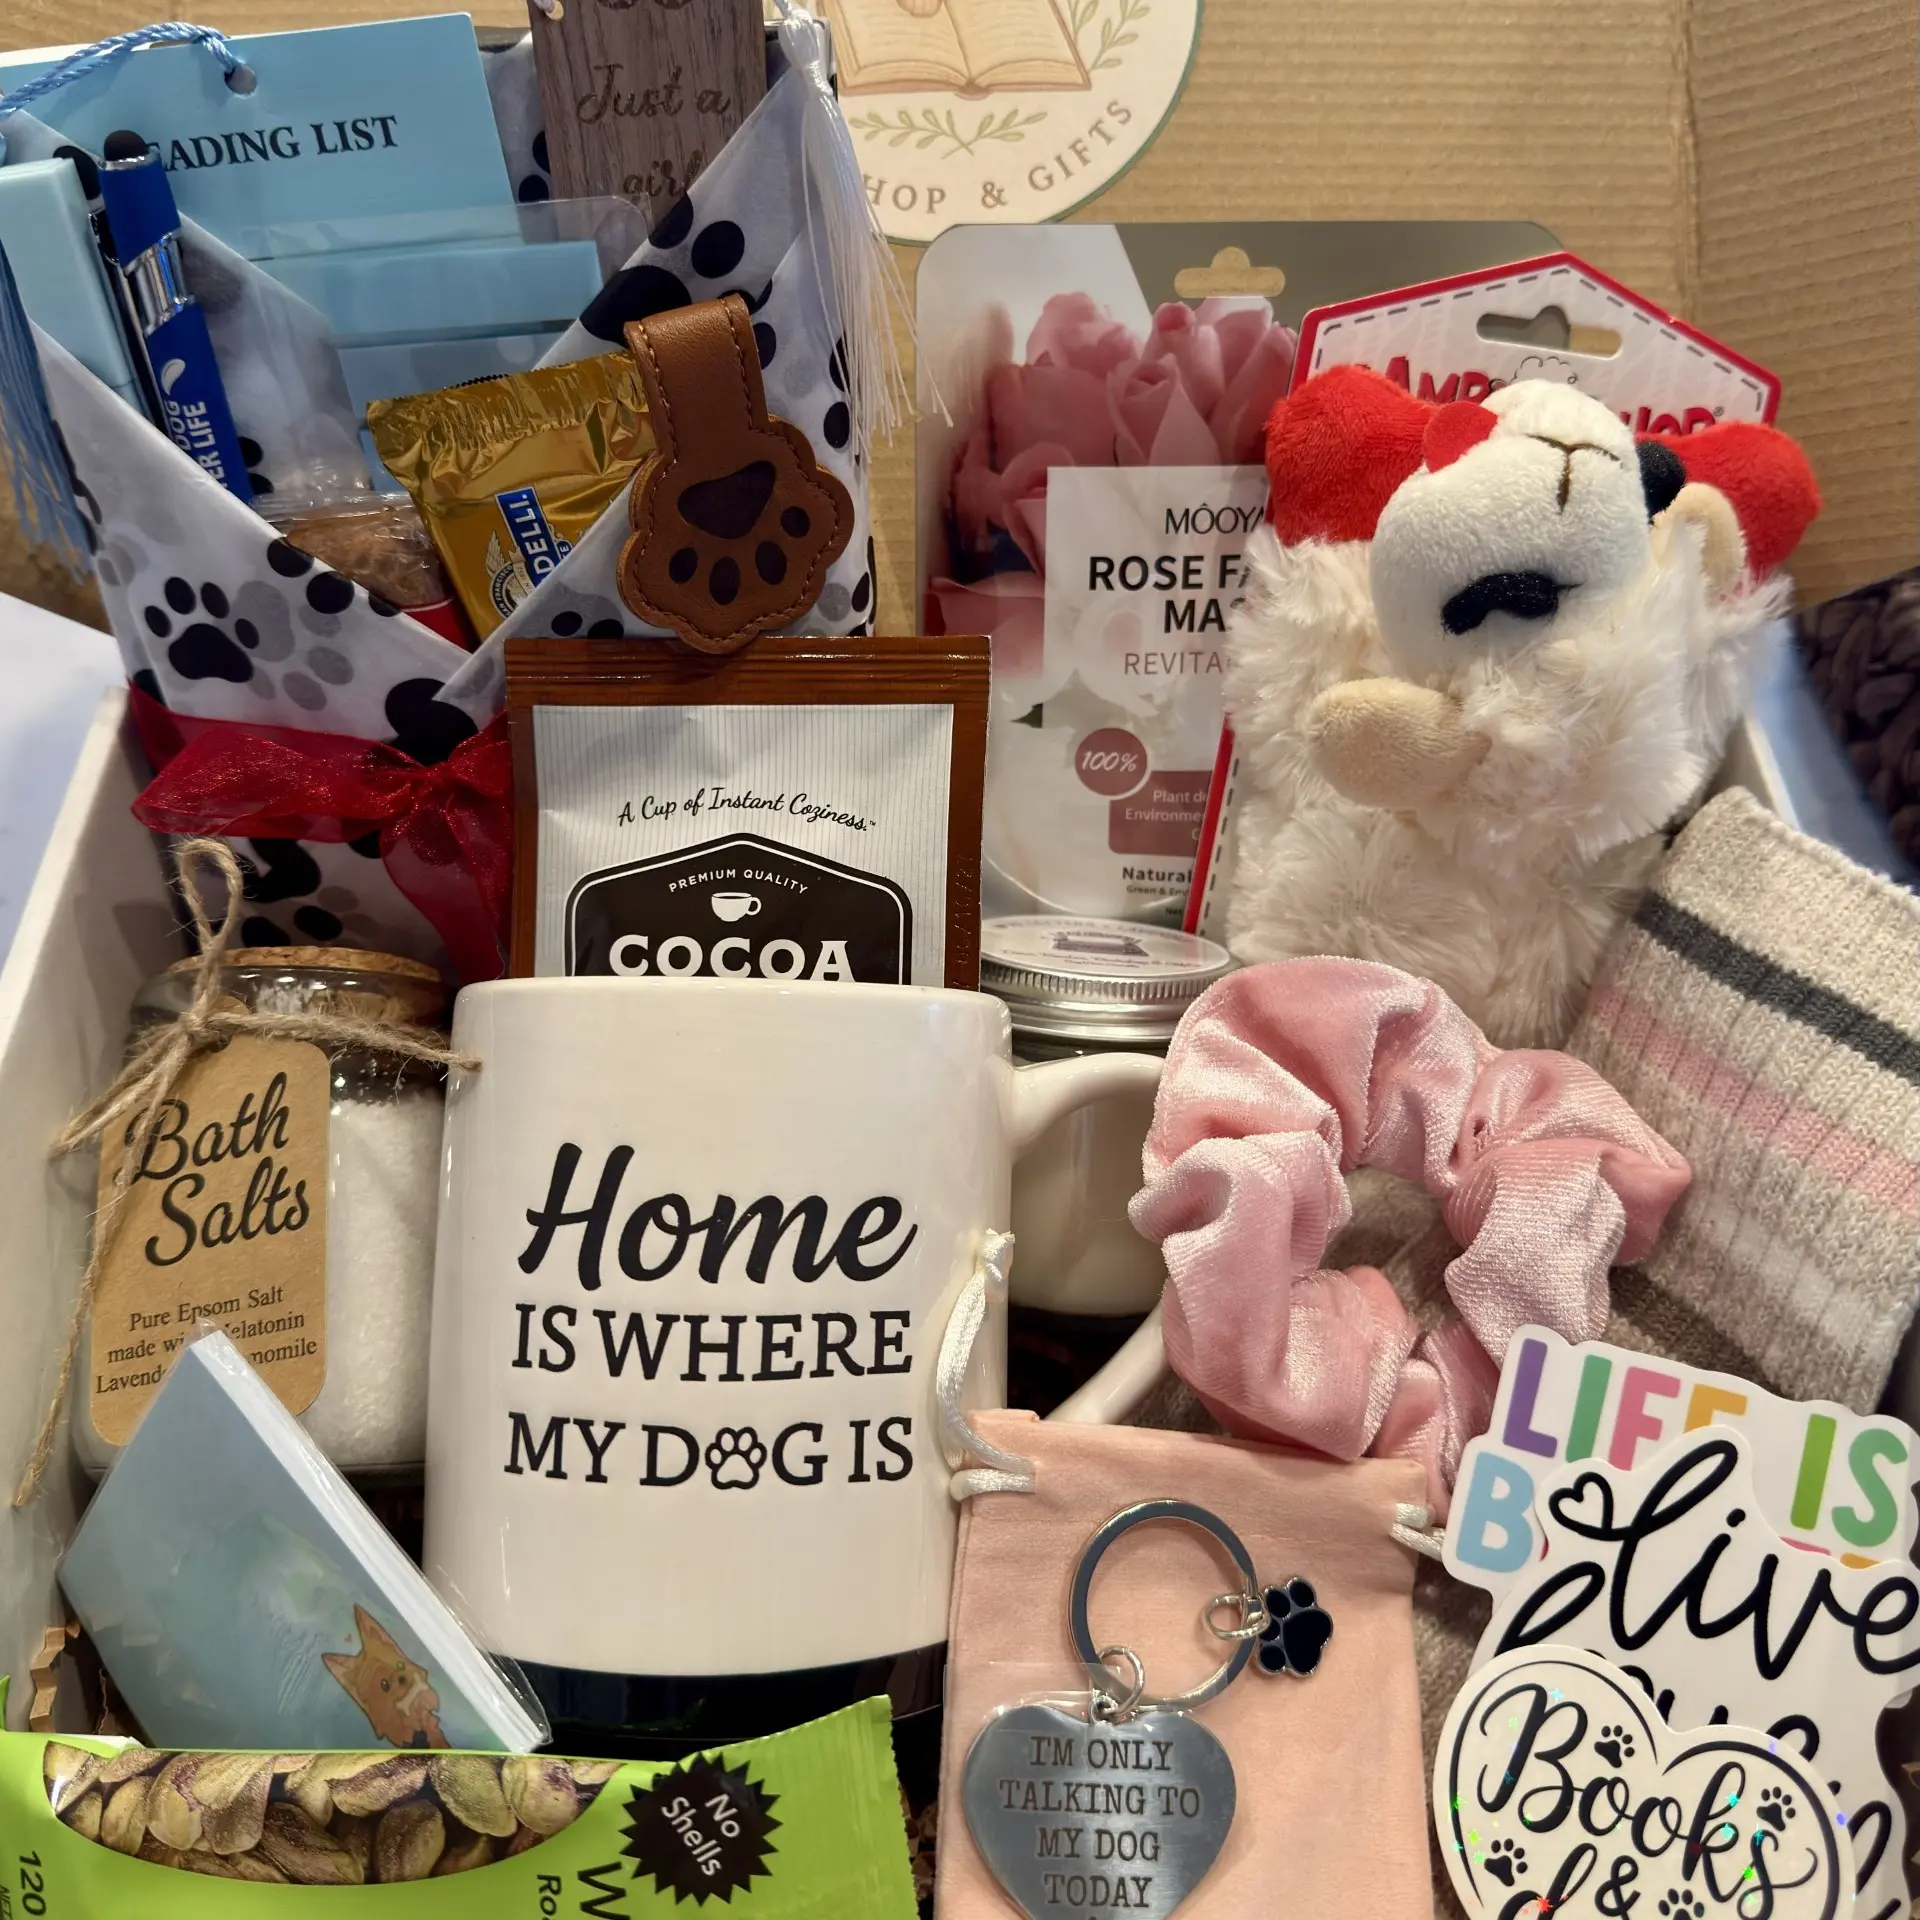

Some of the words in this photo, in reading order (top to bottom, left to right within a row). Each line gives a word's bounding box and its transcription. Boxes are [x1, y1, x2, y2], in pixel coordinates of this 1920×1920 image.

[576, 63, 684, 124] Just
[696, 89, 731, 115] a
[309, 115, 398, 155] LIST
[862, 174, 947, 214] HOP
[980, 181, 1008, 209] &
[1027, 100, 1132, 192] GIFTS
[183, 401, 216, 449] LIFE
[1089, 555, 1205, 591] ROSE
[1124, 651, 1226, 676] REVITA
[1081, 751, 1139, 773] 100%
[618, 801, 635, 826] A
[641, 796, 677, 820] Cup
[683, 788, 704, 816] of
[708, 787, 784, 811] Instant
[1125, 808, 1206, 822] Environme
[1153, 790, 1190, 804] Plant
[668, 868, 737, 893] PREMIUM
[743, 869, 809, 894] QUALITY
[1122, 867, 1192, 883] Natural
[609, 934, 856, 983] COCOA
[112, 1072, 289, 1185] Bath
[145, 1156, 309, 1266] Salts
[517, 1142, 918, 1291] Home
[129, 1311, 171, 1332] Pure
[178, 1298, 241, 1322] Epsom
[248, 1286, 283, 1309] Salt
[107, 1339, 156, 1364] made
[224, 1311, 305, 1340] elatonin
[511, 1303, 577, 1372] IS
[593, 1309, 913, 1382] WHERE
[96, 1364, 166, 1394] Lavend
[250, 1338, 317, 1366] momile
[504, 1411, 626, 1484] MY
[848, 1416, 914, 1483] IS
[1790, 1413, 1908, 1547] IS
[1030, 1736, 1074, 1766] I'M
[1087, 1738, 1174, 1771] ONLY
[705, 1793, 741, 1839] No
[999, 1779, 1146, 1815] TALKING
[1157, 1786, 1200, 1818] TO
[1477, 1682, 1818, 1920] Books
[661, 1796, 722, 1877] Shells
[1038, 1827, 1084, 1858] MY
[1095, 1829, 1160, 1861] DOG
[19, 1850, 47, 1917] 120
[1044, 1873, 1152, 1908] TODAY
